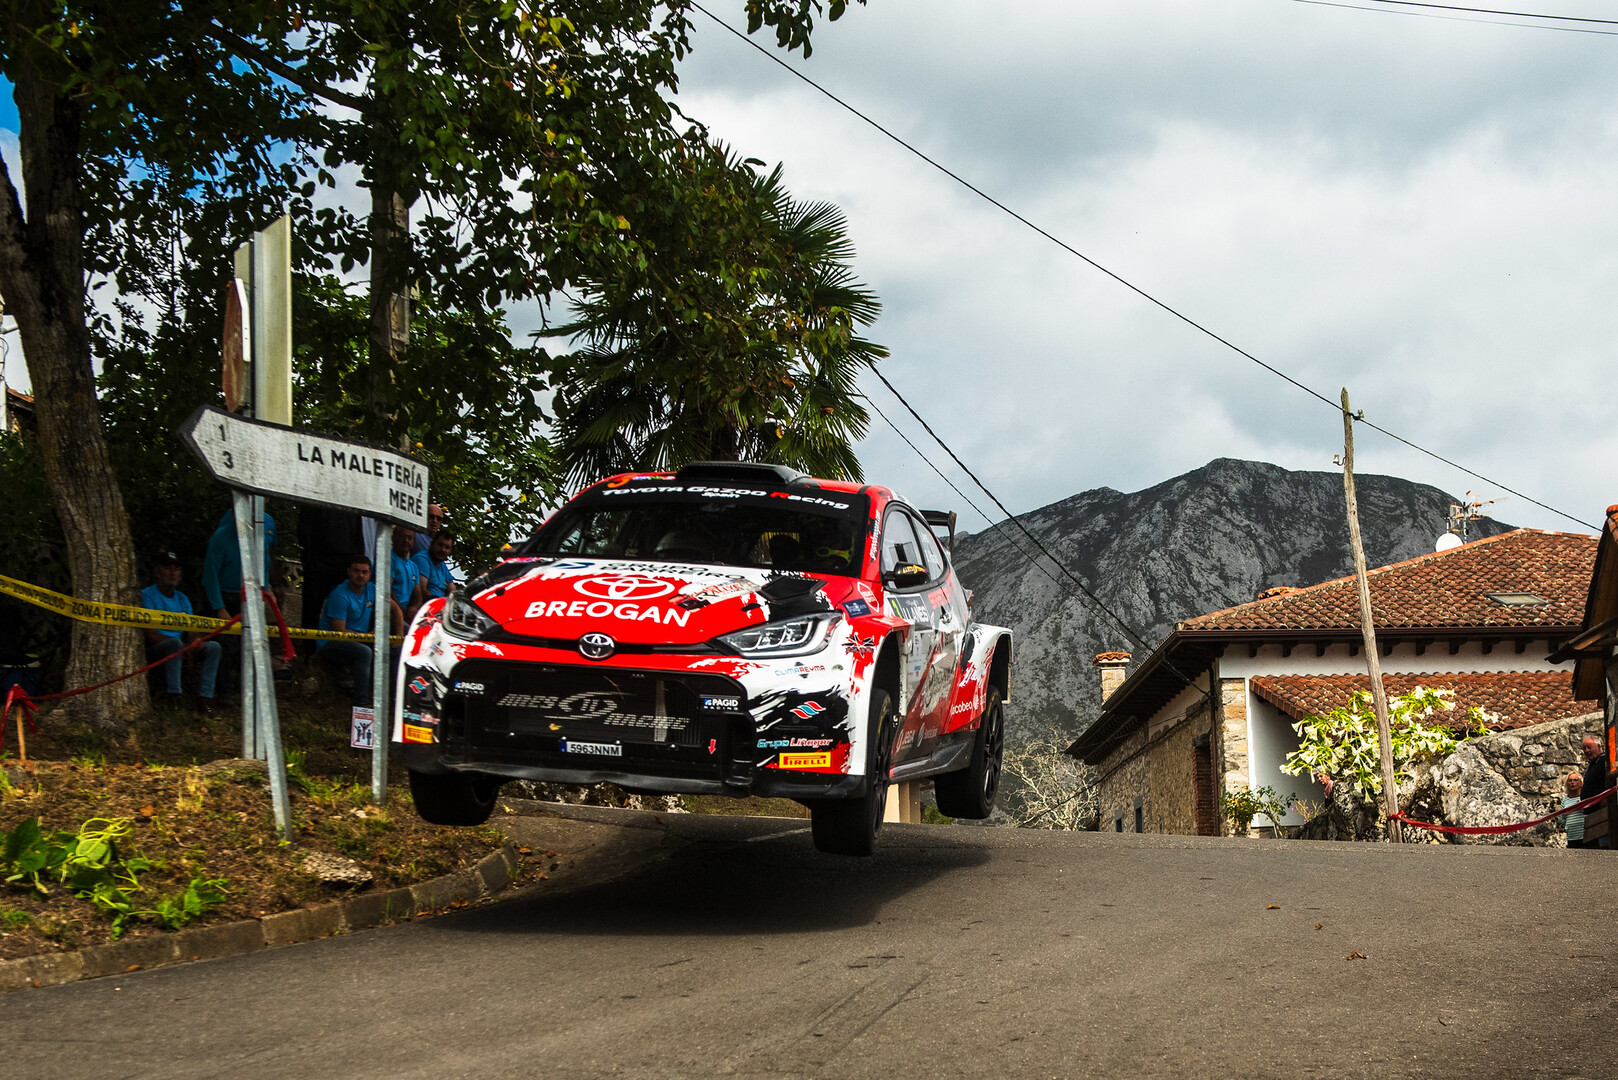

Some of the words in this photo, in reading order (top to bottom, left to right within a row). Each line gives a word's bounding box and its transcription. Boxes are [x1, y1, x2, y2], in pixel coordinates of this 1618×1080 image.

[218, 424, 226, 442] 1
[297, 442, 324, 466] LA
[331, 449, 424, 491] MALETERÍA
[222, 450, 234, 470] 3
[389, 486, 423, 517] MERÉ
[602, 485, 684, 496] TOYOTA
[687, 485, 767, 497] GAZOO
[770, 491, 850, 510] Racing
[701, 491, 740, 499] Spain
[600, 565, 746, 580] BARREIRO
[606, 562, 710, 573] GRUPO
[71, 601, 100, 619] ZONA
[104, 607, 151, 624] PUBLICO
[160, 613, 188, 628] ZONA
[524, 601, 691, 628] BREOGAN
[712, 698, 739, 707] PAGID
[570, 743, 620, 756] 5963NNM
[757, 738, 790, 749] Grupo
[783, 755, 827, 766] PIRELLI
